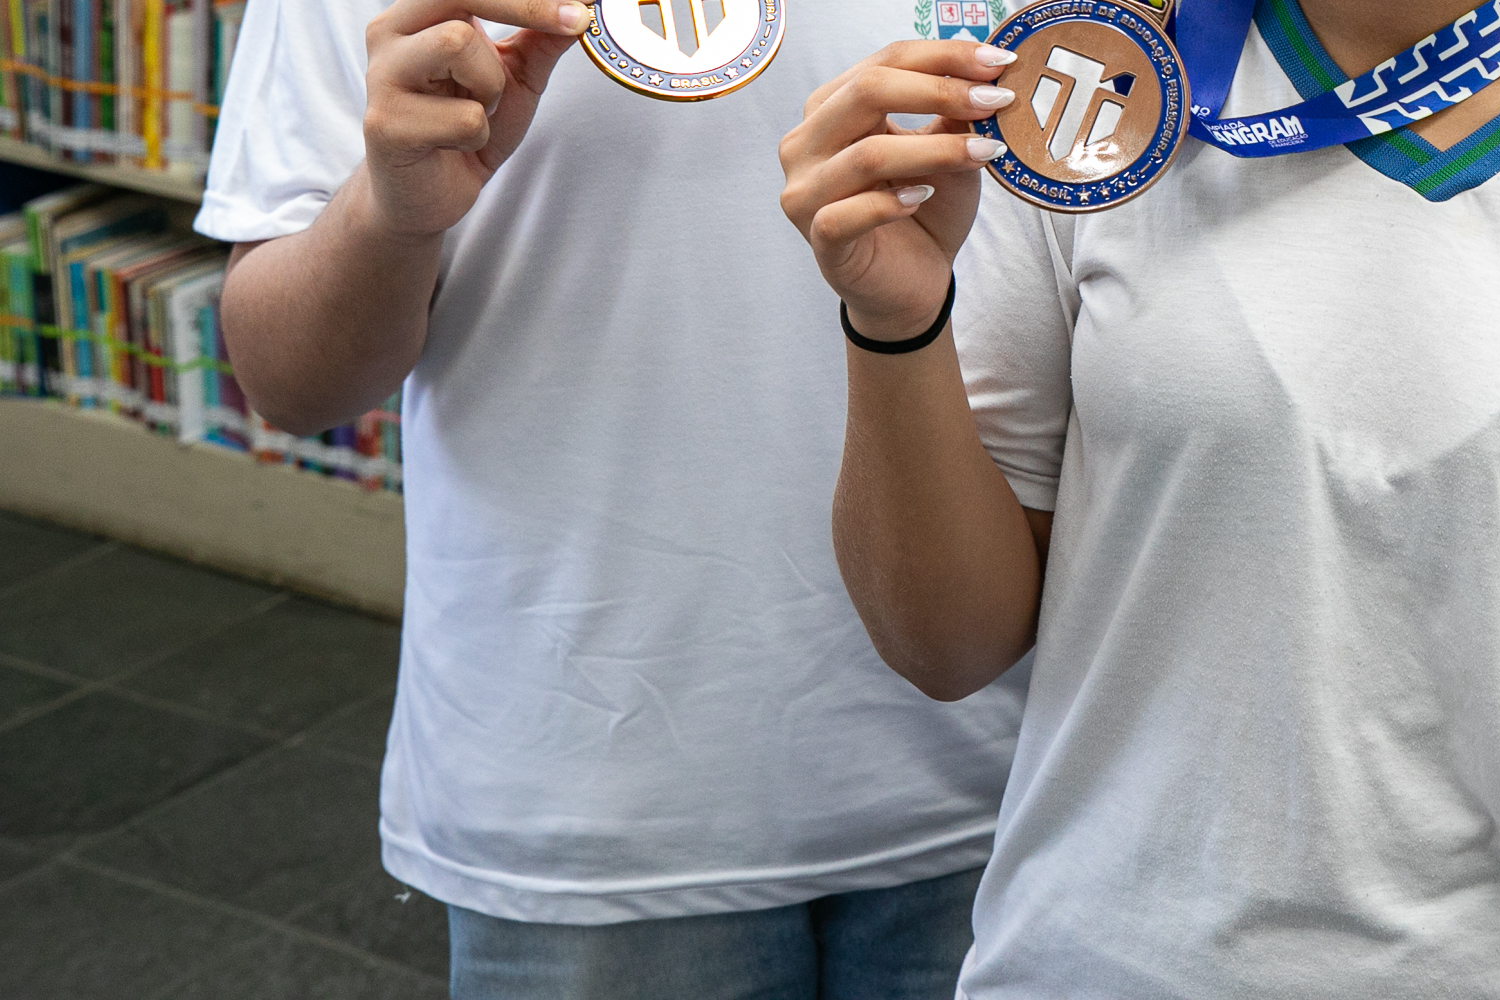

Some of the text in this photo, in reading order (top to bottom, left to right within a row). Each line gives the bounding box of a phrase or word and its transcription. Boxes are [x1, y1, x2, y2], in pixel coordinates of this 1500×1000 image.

[669, 74, 724, 89] BRASIL
[1025, 3, 1179, 158] TANGRAM DE EDUCAÇÃO FINANCEIRA
[1209, 115, 1305, 146] ANGRAM
[1019, 173, 1072, 201] BRASIL
